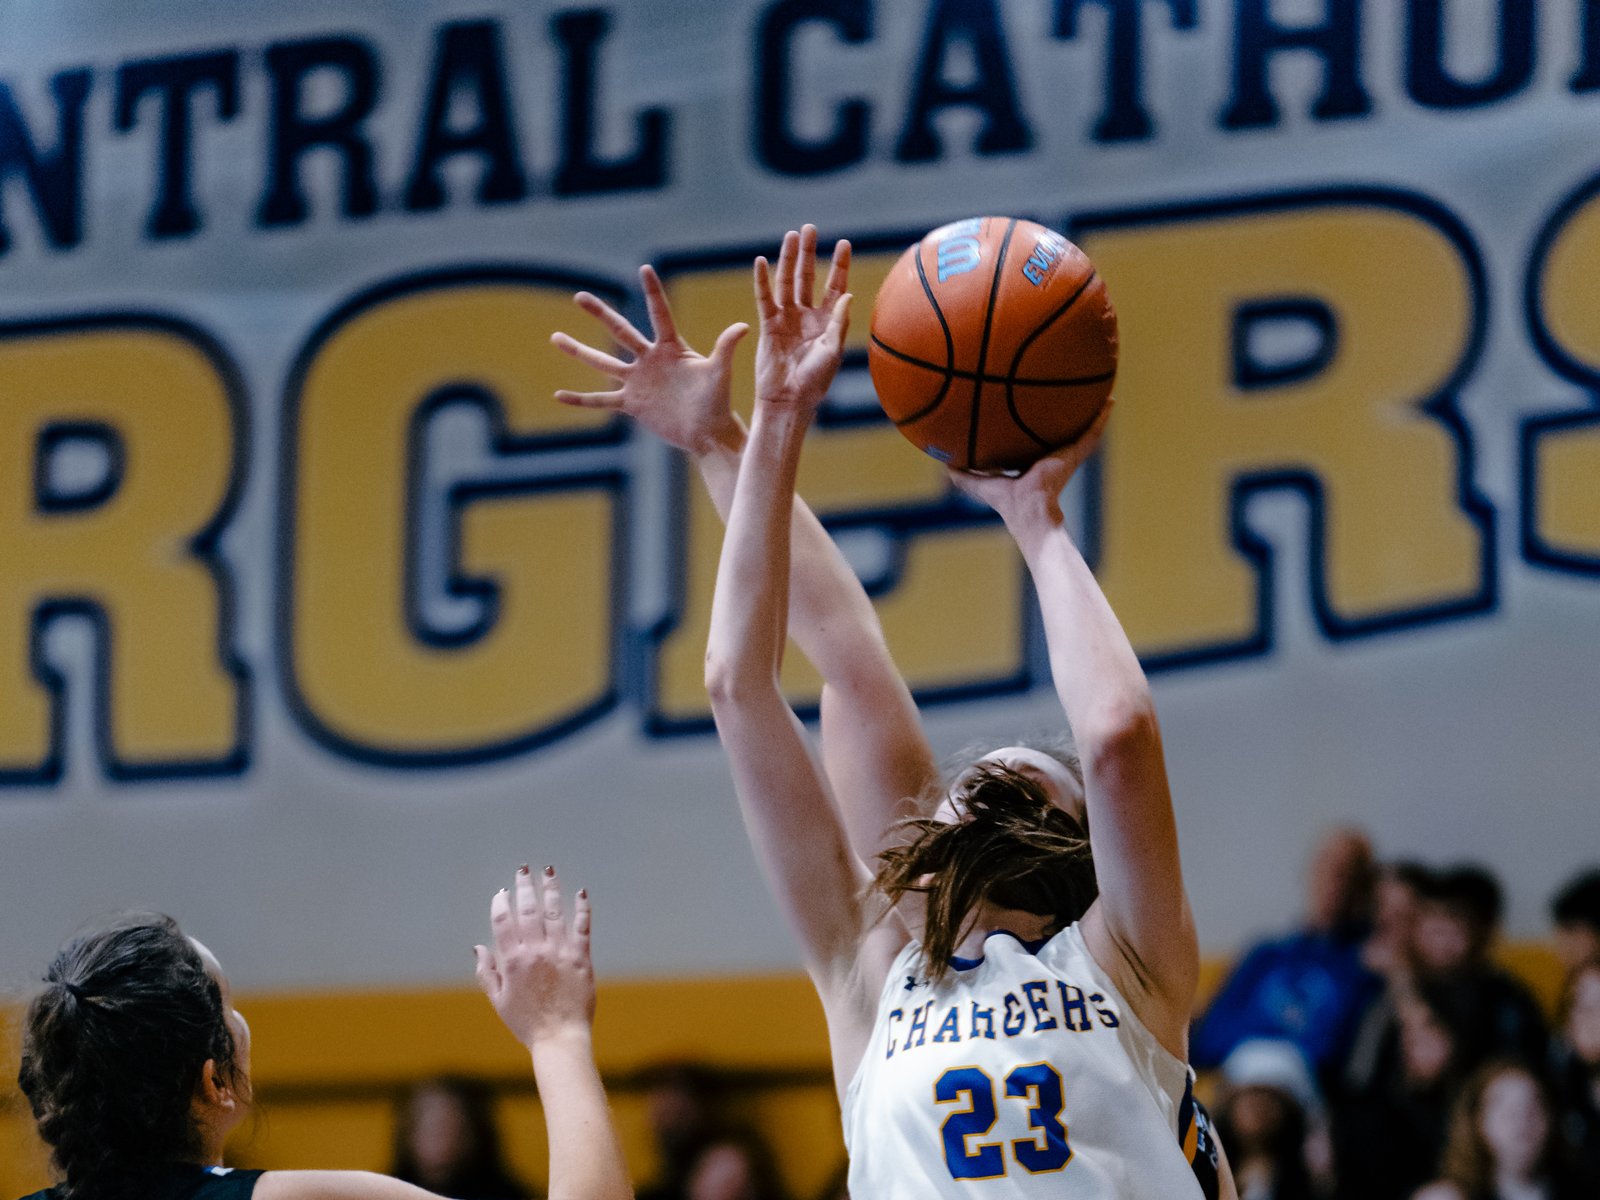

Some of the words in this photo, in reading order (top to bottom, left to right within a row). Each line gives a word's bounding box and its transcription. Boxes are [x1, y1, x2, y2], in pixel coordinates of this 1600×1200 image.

[751, 0, 1600, 177] CATHO
[885, 979, 1120, 1060] CHARGERS
[932, 1060, 1074, 1182] 23
